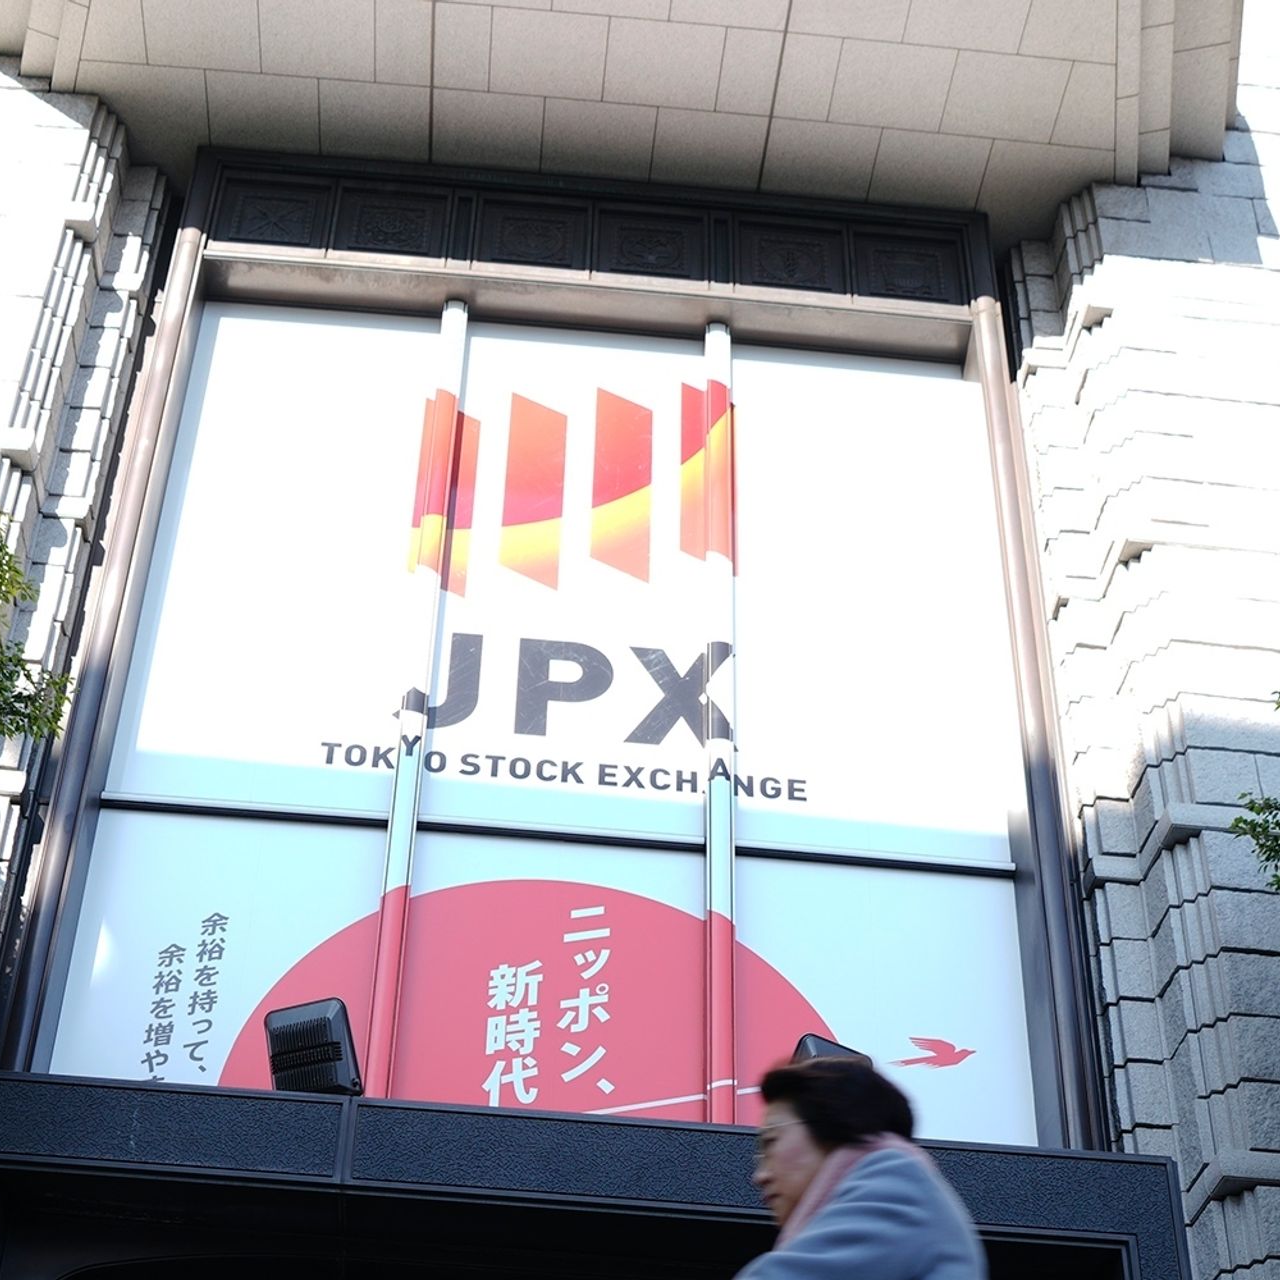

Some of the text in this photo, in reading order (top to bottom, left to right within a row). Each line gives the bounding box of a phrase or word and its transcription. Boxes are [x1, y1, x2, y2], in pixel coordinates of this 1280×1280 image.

[392, 632, 739, 752] JPX
[321, 735, 808, 801] TOKYO STOCK EXCHANGE
[140, 943, 186, 1083] 余裕を増や
[183, 912, 229, 1073] 余裕を持って、
[481, 959, 543, 1107] 新時代
[557, 905, 615, 1095] ニッポン、
